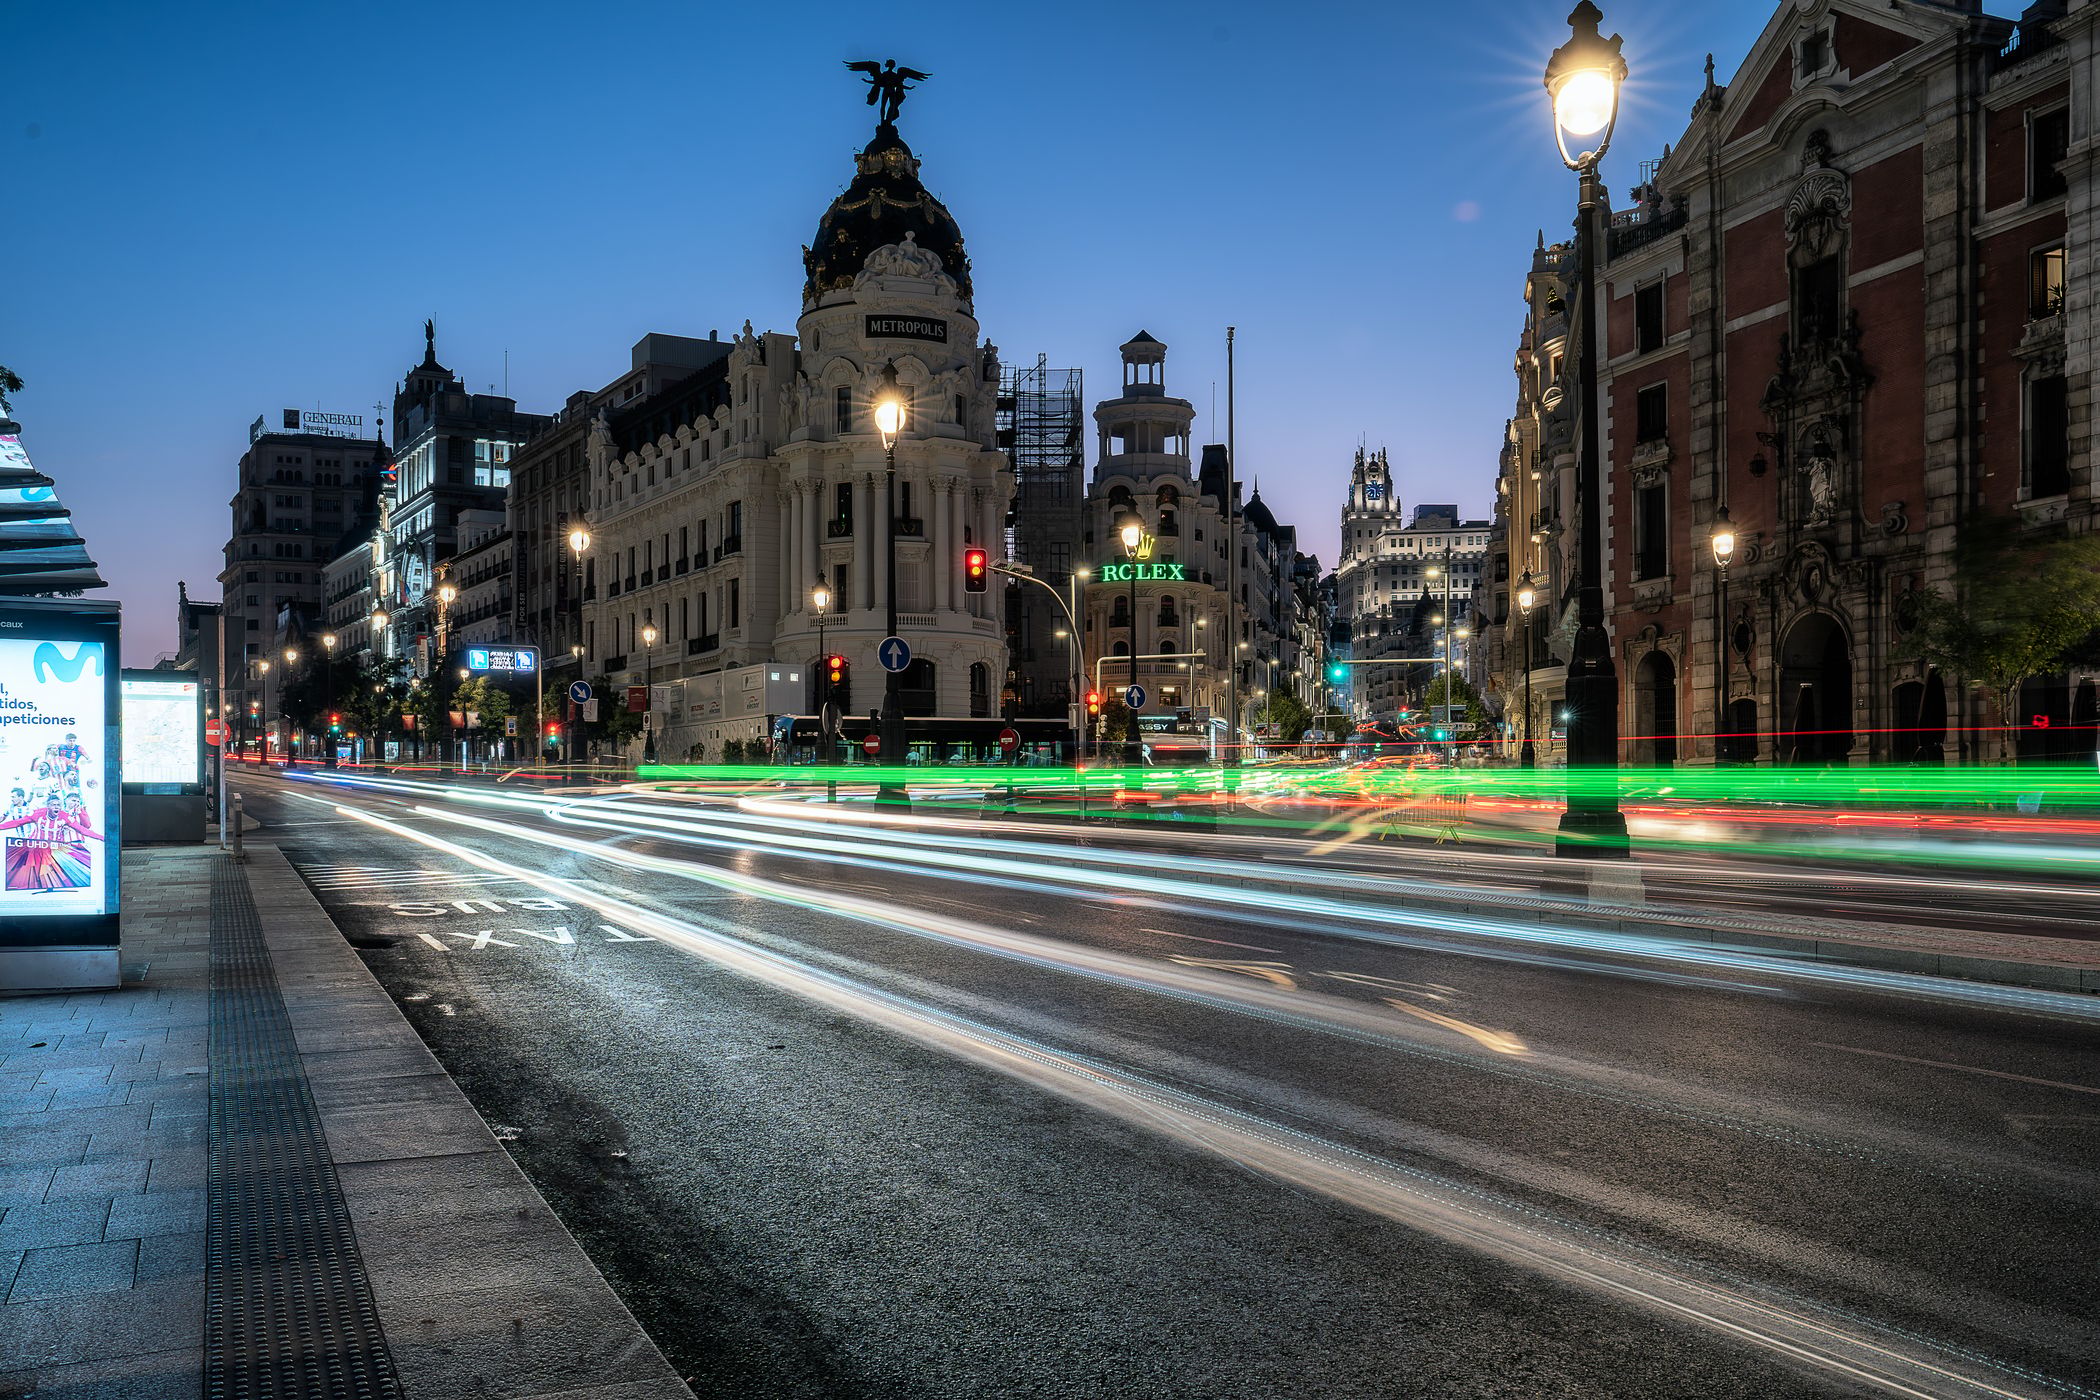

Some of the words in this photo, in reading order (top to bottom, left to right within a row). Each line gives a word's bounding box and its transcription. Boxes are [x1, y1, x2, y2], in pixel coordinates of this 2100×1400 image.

[871, 320, 944, 337] METROPOLIS
[303, 411, 362, 426] GENERALI
[0, 713, 76, 727] peticiones
[8, 838, 23, 847] LG
[27, 840, 49, 849] UHD
[388, 898, 571, 917] BUS
[416, 925, 657, 952] TAXI
